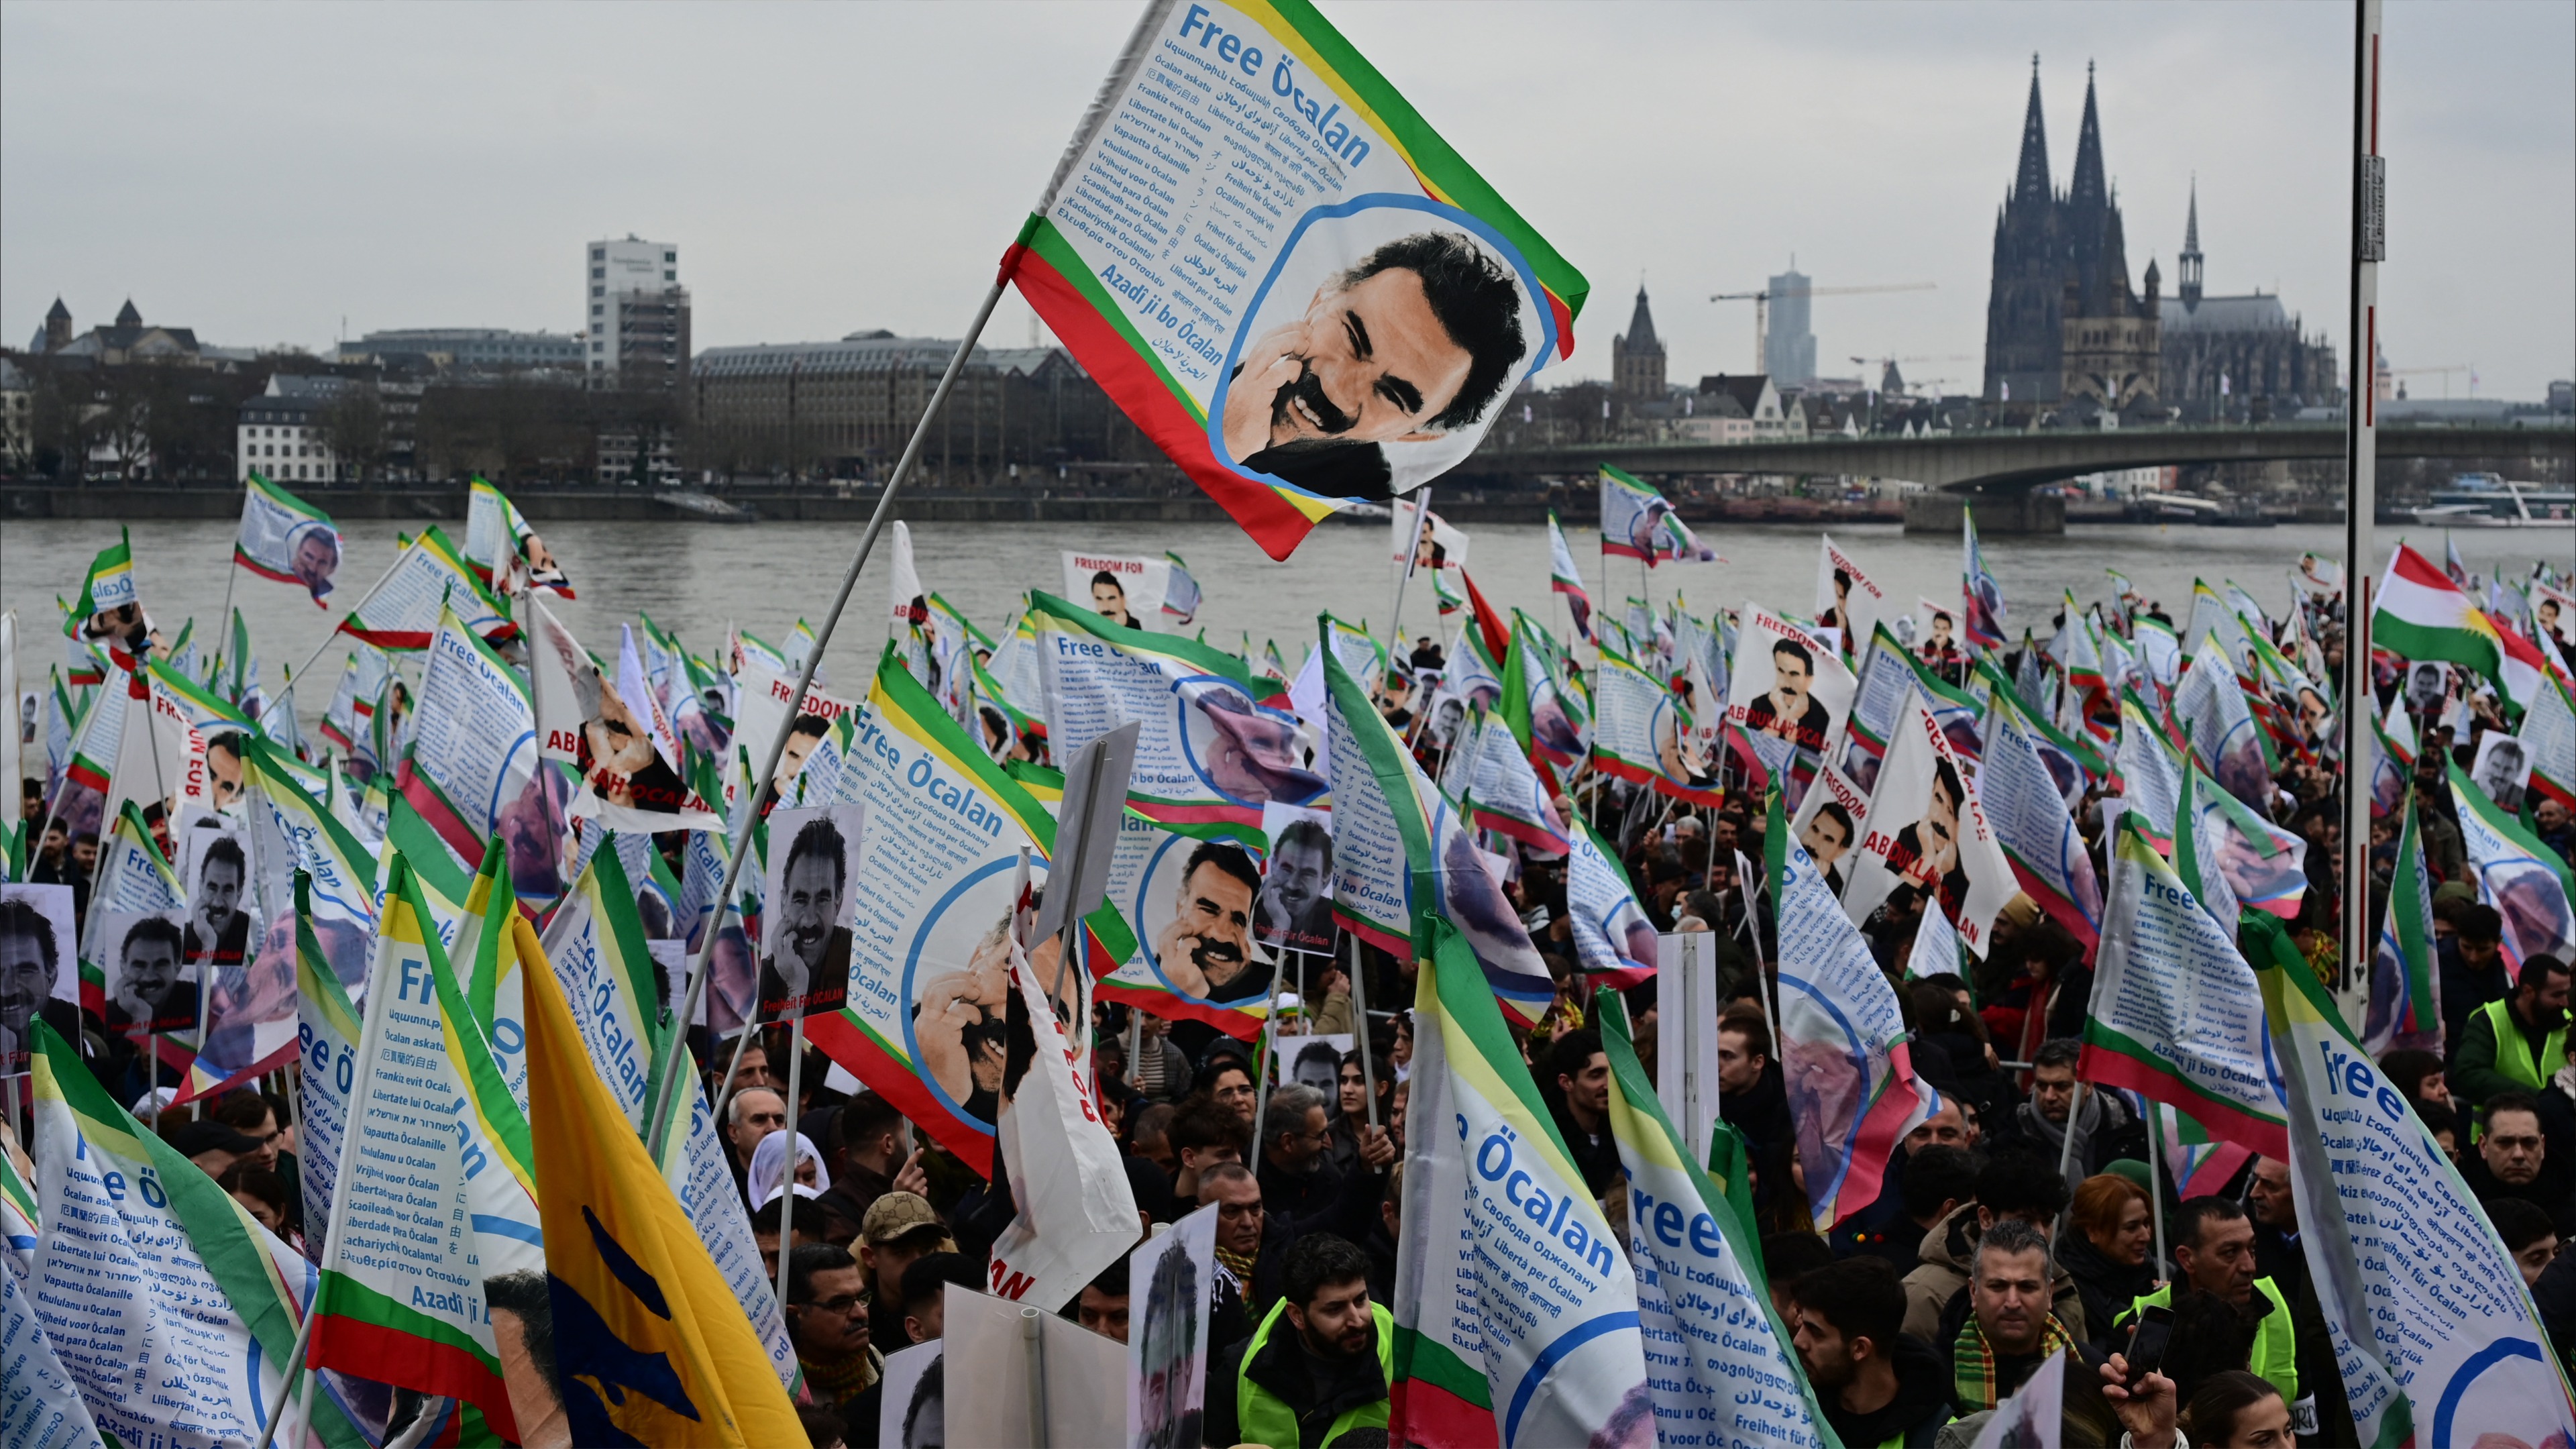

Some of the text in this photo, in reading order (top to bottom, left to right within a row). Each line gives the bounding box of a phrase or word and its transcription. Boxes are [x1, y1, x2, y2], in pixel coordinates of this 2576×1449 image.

[1155, 55, 1212, 93] Öcalan askatu
[1179, 3, 1370, 168] Free Öcalan
[1129, 98, 1203, 148] Libertate lui Ocalan
[1138, 83, 1211, 132] Frankiz evit Ocalan
[1208, 105, 1260, 143] Libérez Öcalan
[1273, 107, 1310, 141] Свобода
[1103, 138, 1143, 165] Khululanu
[1152, 166, 1177, 186] Ocalan
[1114, 124, 1189, 174] Vapautta Öcalanille
[1279, 132, 1342, 191] Libertà per Öcalan
[1089, 162, 1168, 217] Libertad para Öcalan
[1099, 150, 1174, 204] Vrijheid voor Öcalan
[1225, 173, 1281, 217] Freiheit für Öcalan
[1075, 186, 1157, 245] Liberdade para Öcalan
[1082, 175, 1167, 235] Scaoileadh saor Öcalan
[1216, 186, 1246, 210] Ocalani
[1119, 232, 1155, 261] Ocalanta!
[1194, 234, 1246, 278] Öcalan'a Özgürlük
[1206, 221, 1255, 262] Frihet för Öcalan
[1170, 264, 1197, 288] Llibertat
[1195, 286, 1208, 297] per
[1214, 297, 1232, 316] Ocalan
[1100, 264, 1222, 366] Azadî ji bo Öcalan
[415, 553, 442, 578] Free
[1075, 557, 1144, 574] FREEDOM FOR
[441, 631, 475, 667] Free
[1057, 637, 1104, 657] Free
[1756, 612, 1819, 652] FREEDOM
[1880, 651, 1904, 671] Free
[1728, 704, 1796, 736] ABDULLAH
[2002, 722, 2032, 753] Free
[908, 752, 1004, 839] Öcalan
[1140, 772, 1154, 784] bo
[1157, 771, 1195, 784] Öcalan
[913, 796, 989, 849] Свобода Оджалану
[875, 845, 928, 886] Freiheit für Öcalan
[1863, 830, 1941, 890] ABDULLAH
[1360, 883, 1403, 908] Öcalan
[2144, 873, 2195, 910] Free
[1298, 929, 1329, 946] Öcalan
[763, 996, 797, 1013] Freiheit
[812, 987, 845, 1006] ÖCALAN
[849, 963, 898, 1006] Öcalan
[376, 1069, 423, 1088] Frankiz evit
[2200, 1063, 2217, 1077] bo
[2220, 1067, 2267, 1089] Öcalan
[2320, 1040, 2405, 1122] Free
[363, 1125, 446, 1152] Vapautta Öcalanille
[1477, 1124, 1614, 1279] Öcalan
[1483, 1197, 1598, 1293] Свобода Оджалану
[1494, 1238, 1582, 1307] Libertà per Öcalan
[37, 1291, 81, 1312] Khululanu
[90, 1301, 122, 1320] Ocalan
[412, 1284, 464, 1318] Azadî
[2411, 1268, 2467, 1320] für Öcalan
[1735, 1414, 1807, 1445] Freiheit für
